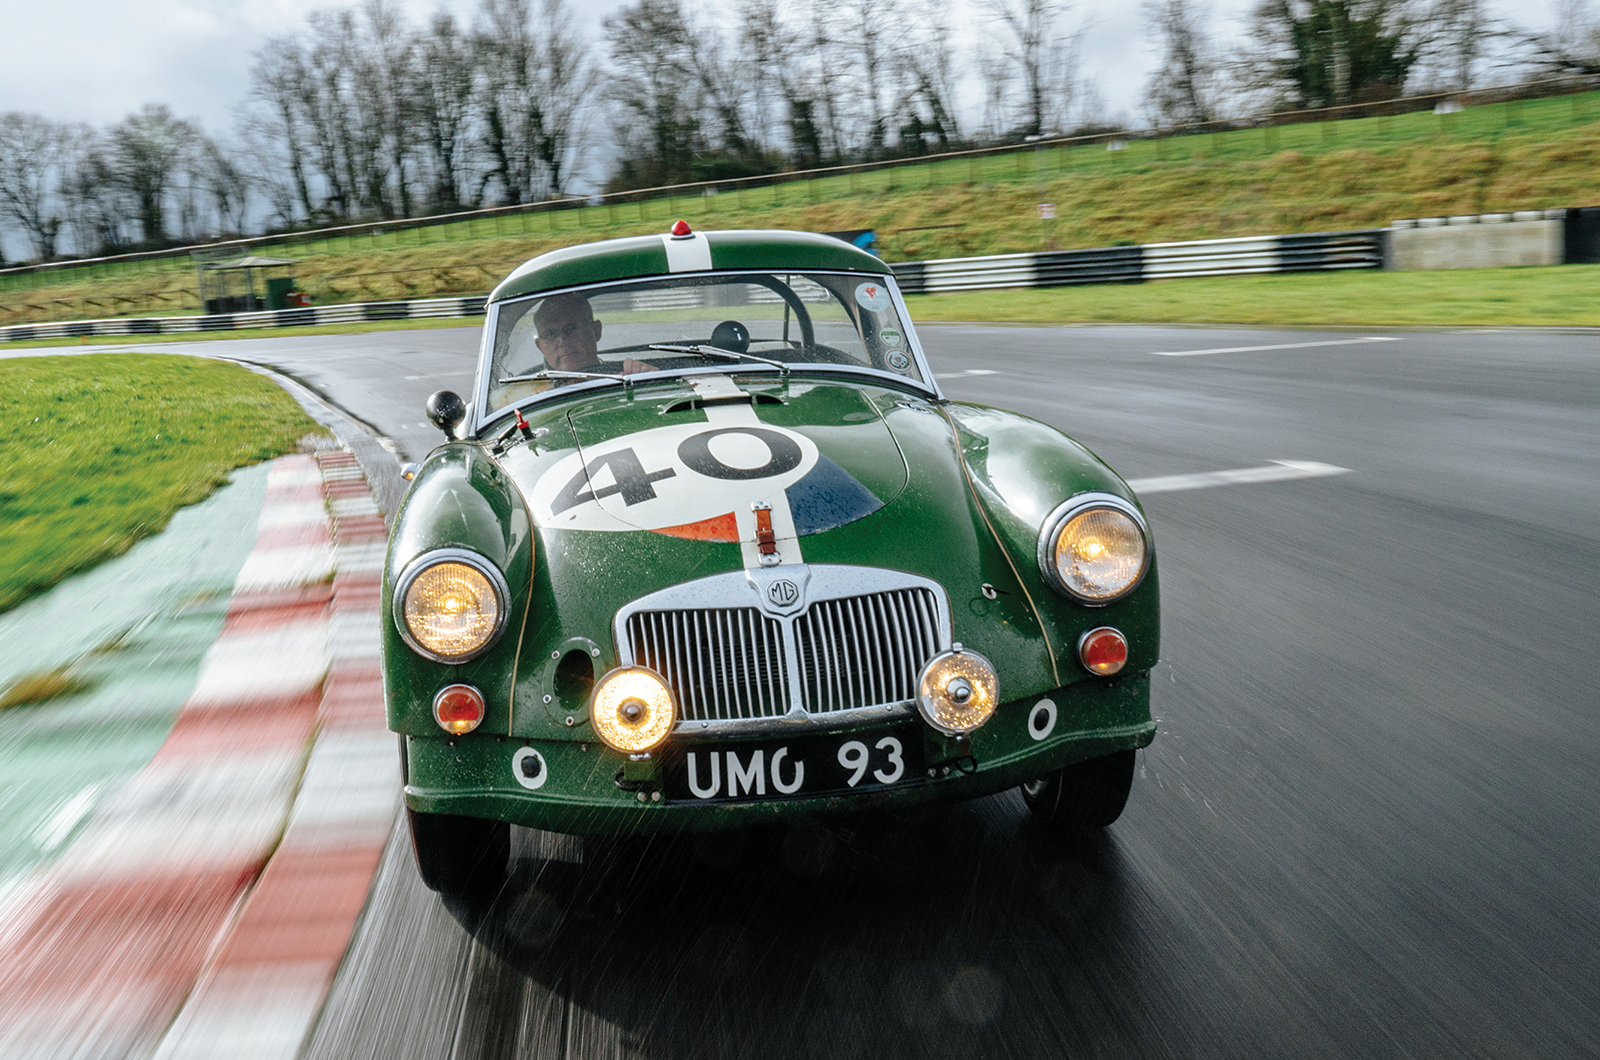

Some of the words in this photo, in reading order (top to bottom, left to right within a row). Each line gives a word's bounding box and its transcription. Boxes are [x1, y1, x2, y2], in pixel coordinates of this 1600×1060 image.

[550, 427, 803, 517] 40
[771, 582, 795, 601] MG
[837, 736, 905, 788] 93
